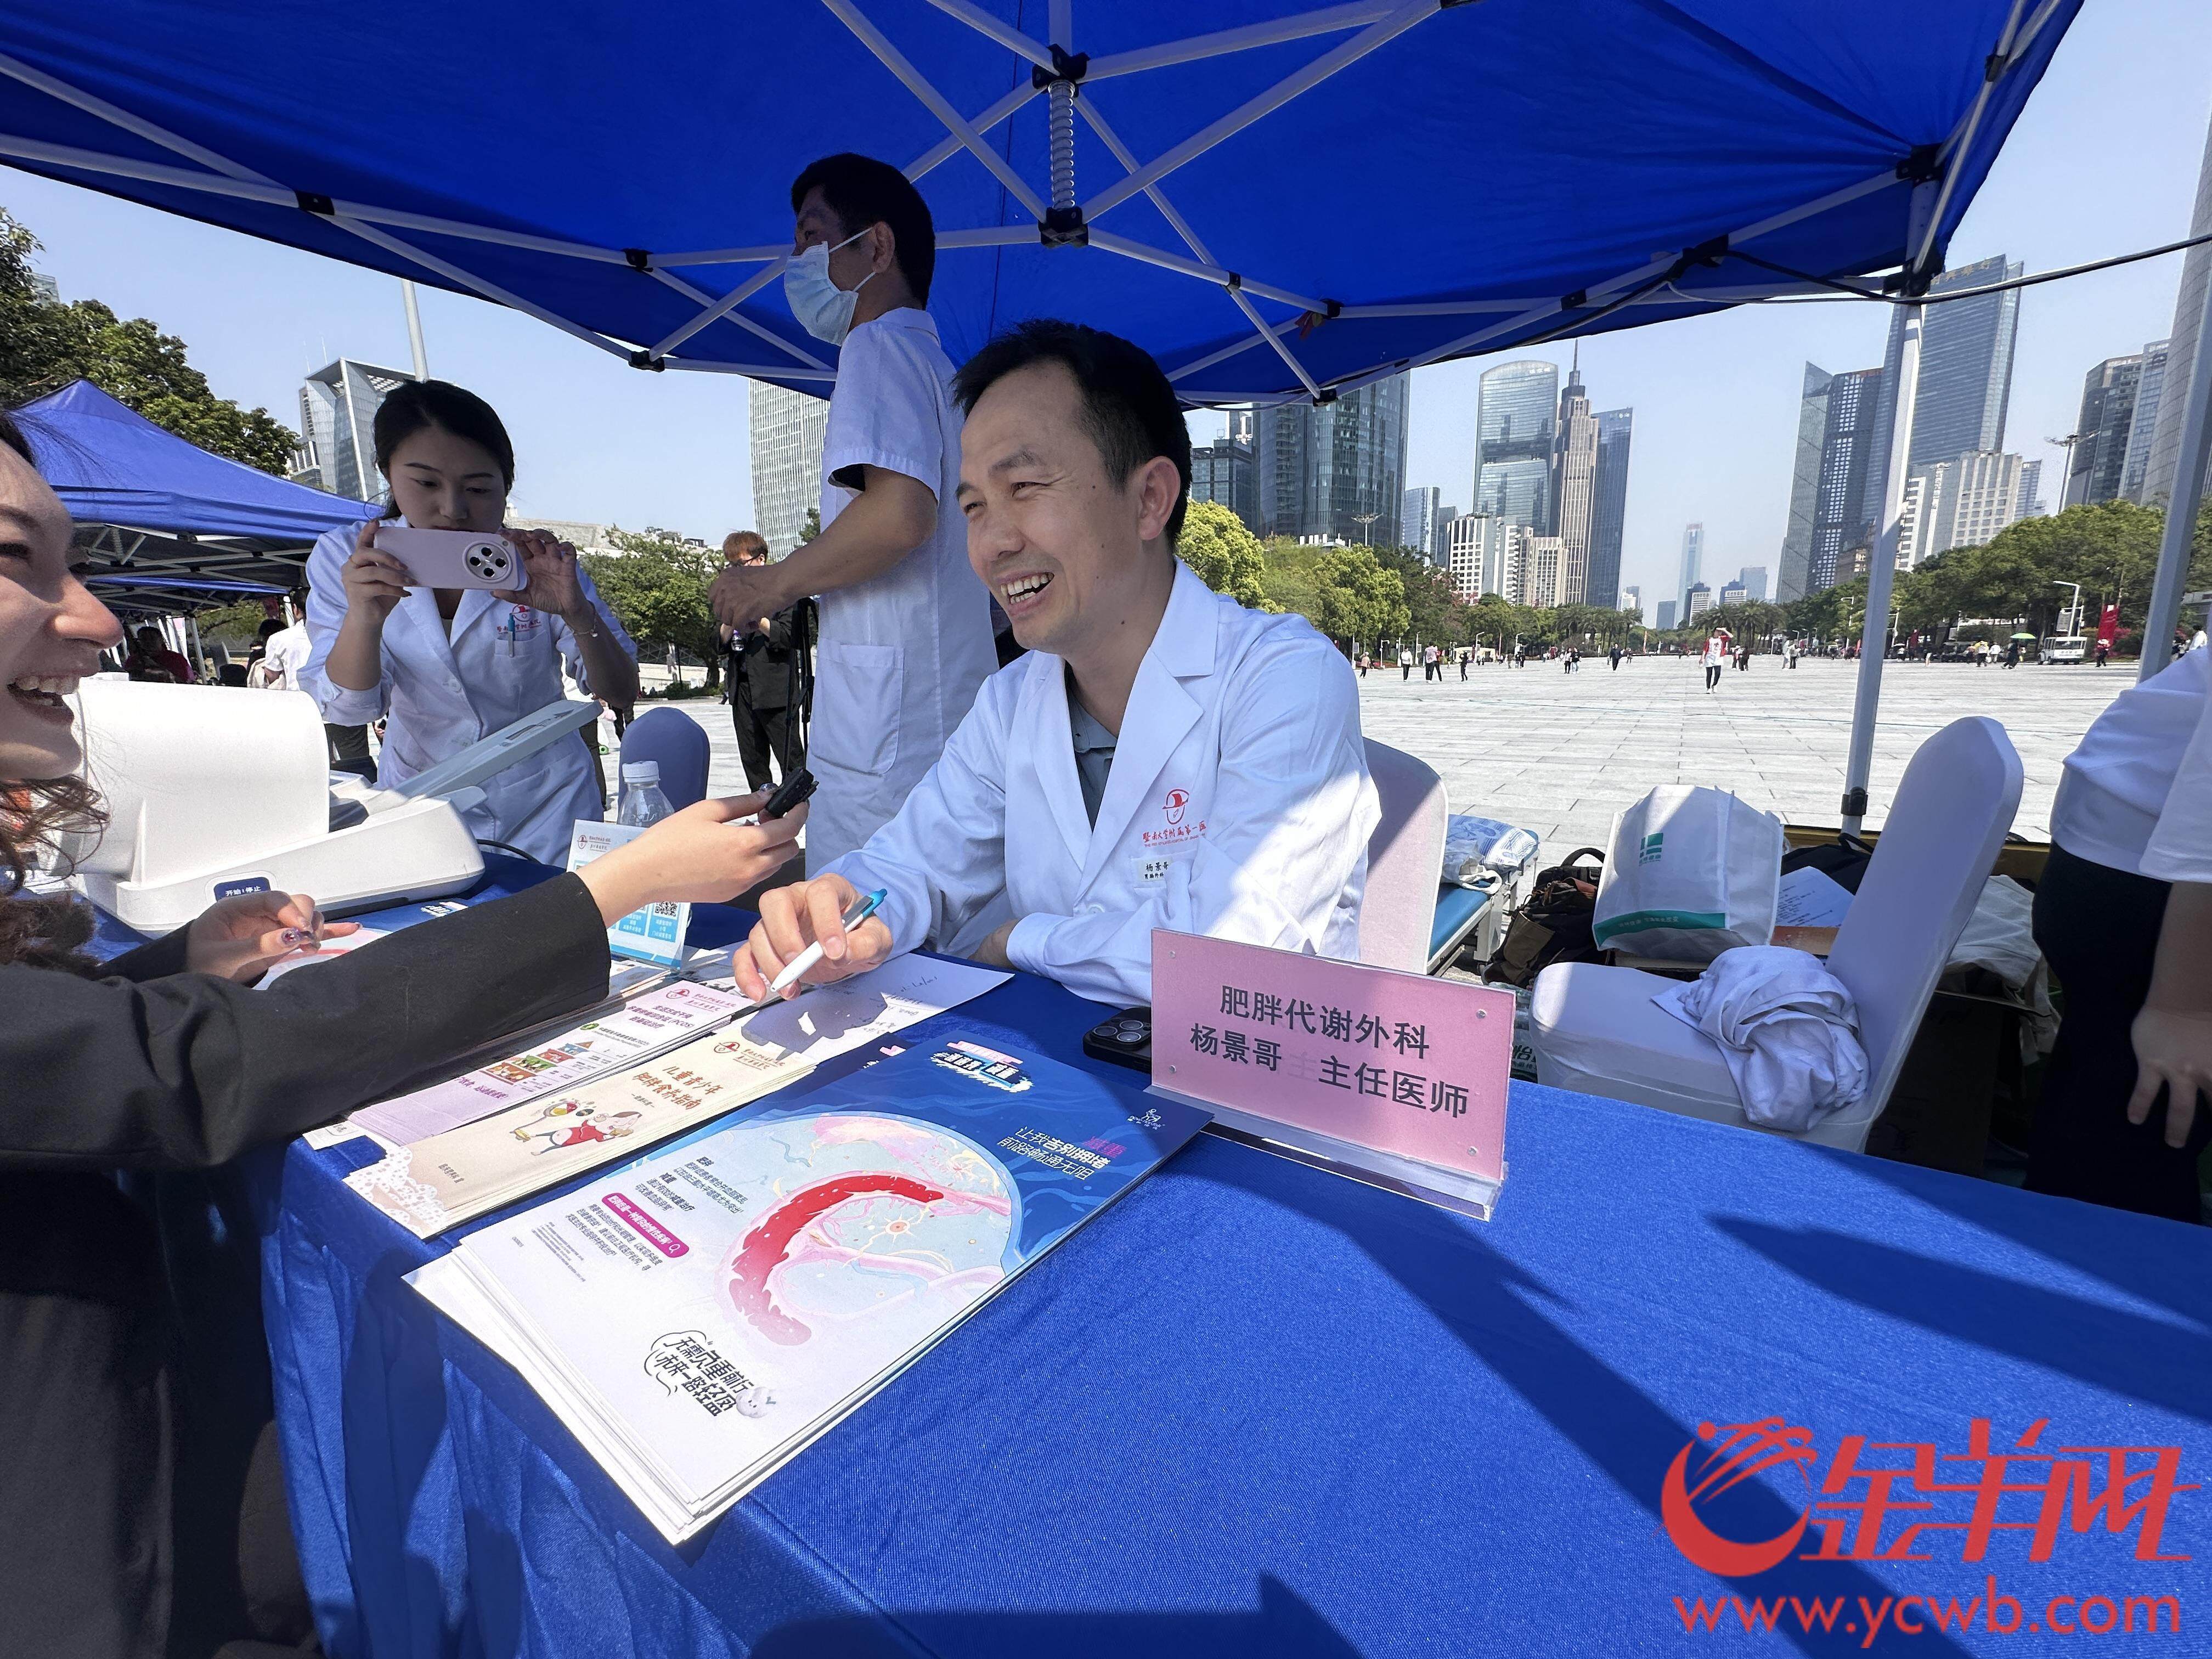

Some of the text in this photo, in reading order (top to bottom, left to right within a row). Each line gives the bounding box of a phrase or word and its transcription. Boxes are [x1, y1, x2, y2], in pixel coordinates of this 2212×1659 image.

[1220, 985, 1430, 1059] 肥胖代谢外科
[662, 1065, 726, 1095] 儿童青少年
[1189, 1022, 1470, 1119] 杨景哥 主任医师
[996, 1136, 1095, 1180] 前路畅通无阻
[1015, 1126, 1111, 1169] 让我告别拥堵
[663, 1336, 754, 1394] 无需负重前行
